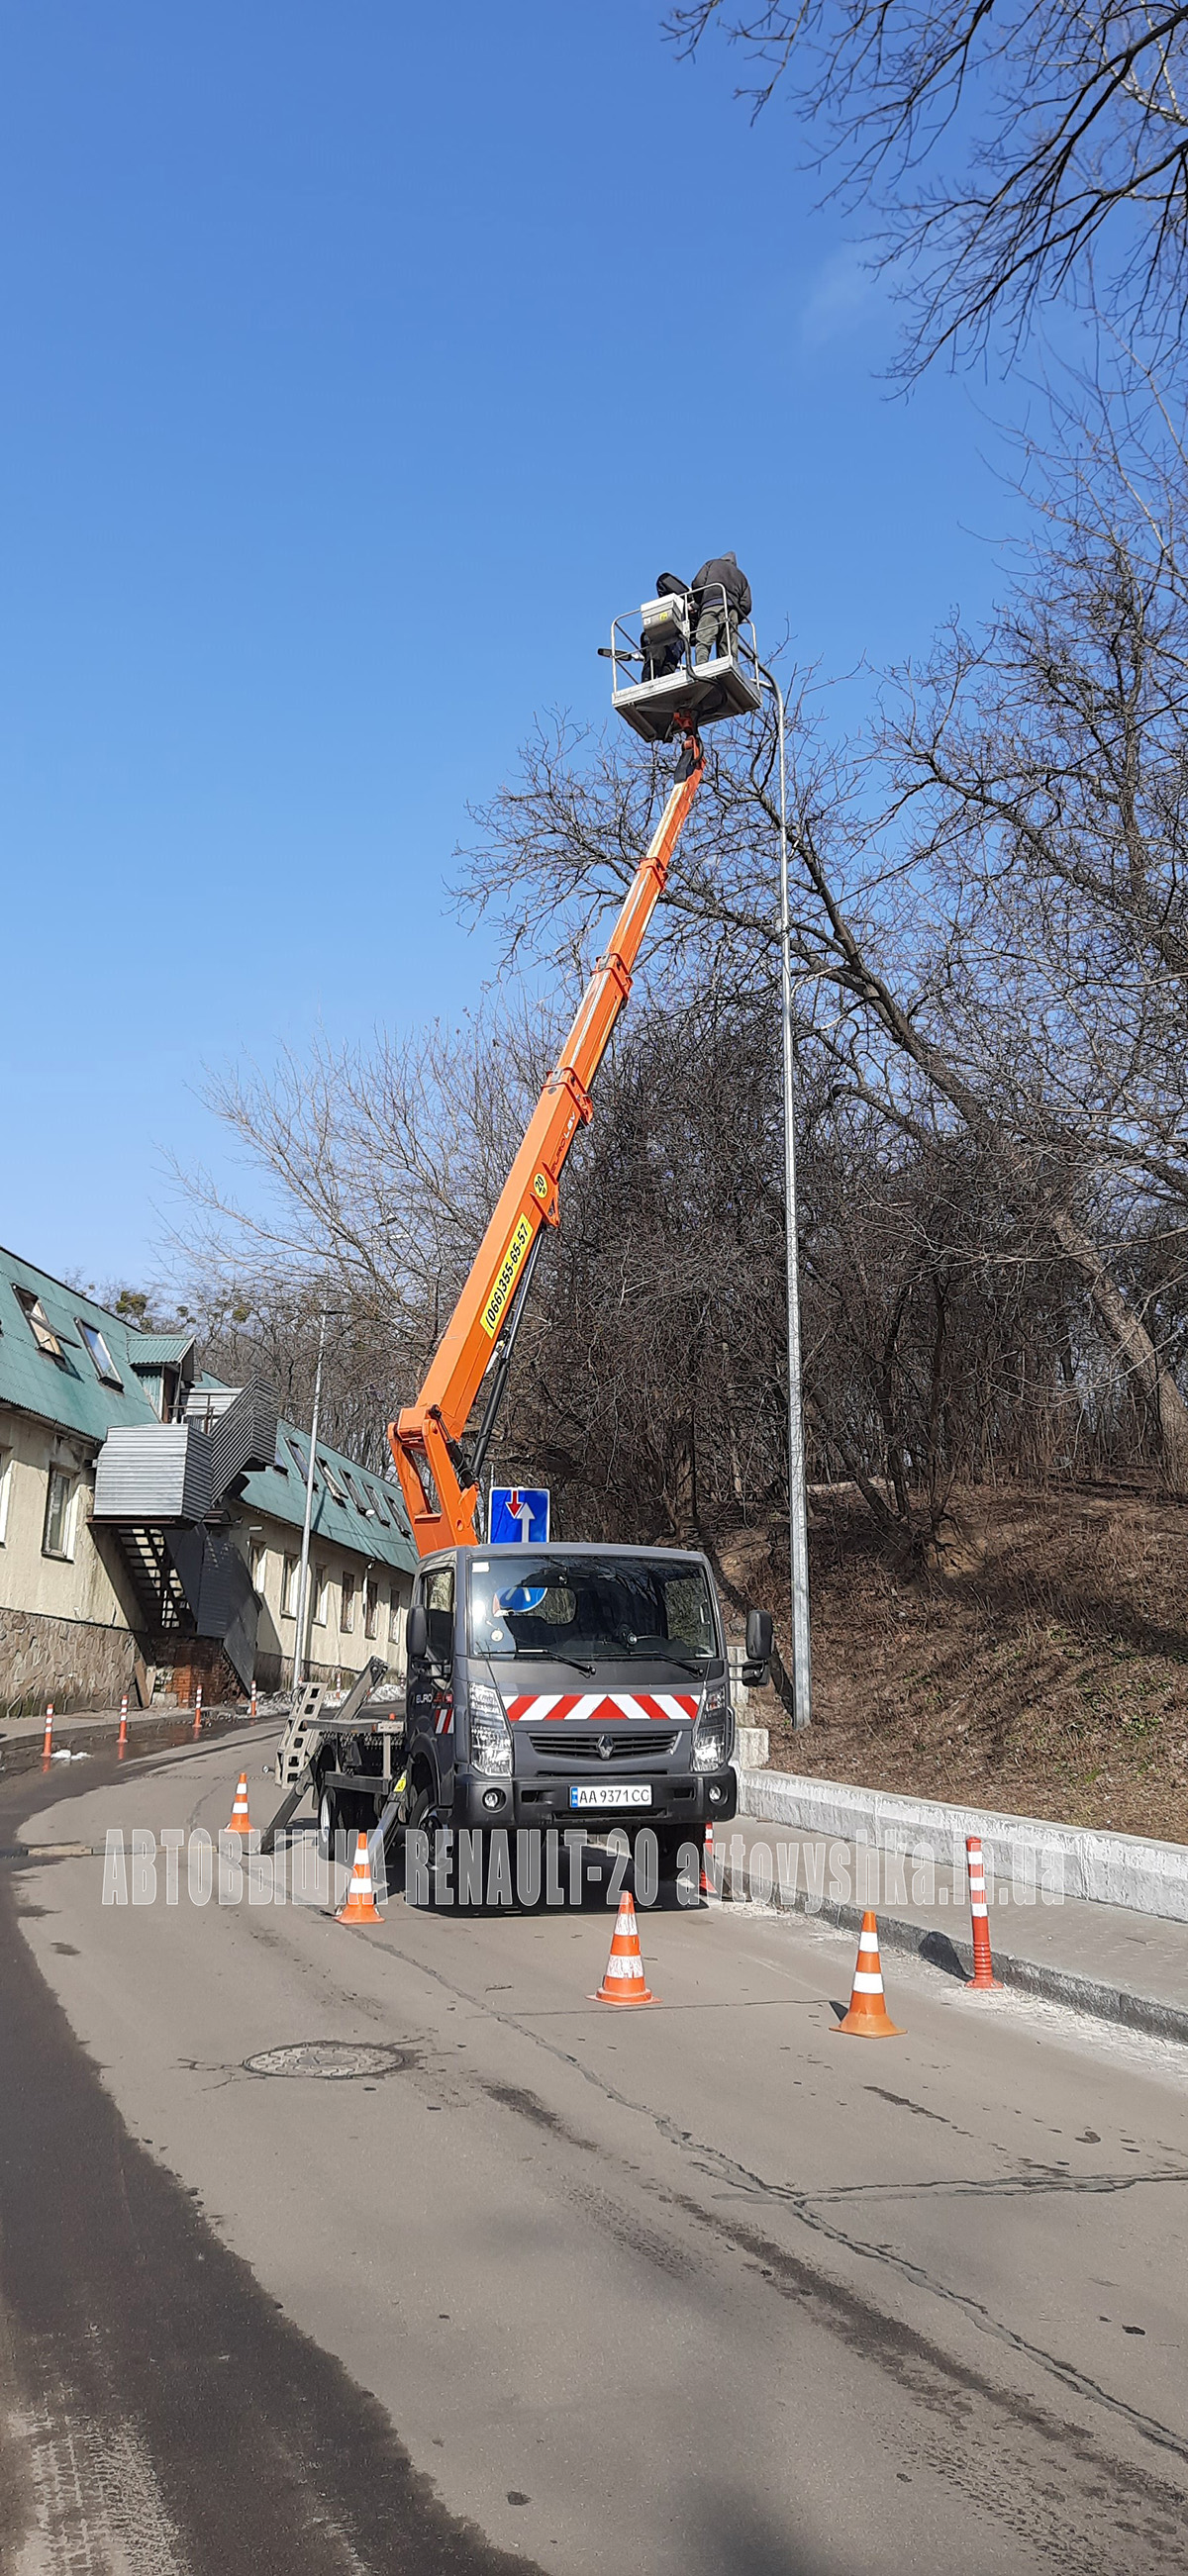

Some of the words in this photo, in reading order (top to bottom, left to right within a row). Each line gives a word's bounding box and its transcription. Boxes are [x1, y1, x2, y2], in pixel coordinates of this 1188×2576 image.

[485, 1222, 529, 1330] (066)355-65-57
[416, 1693, 434, 1705] EURO
[579, 1790, 597, 1803] AA
[600, 1789, 629, 1803] 9371
